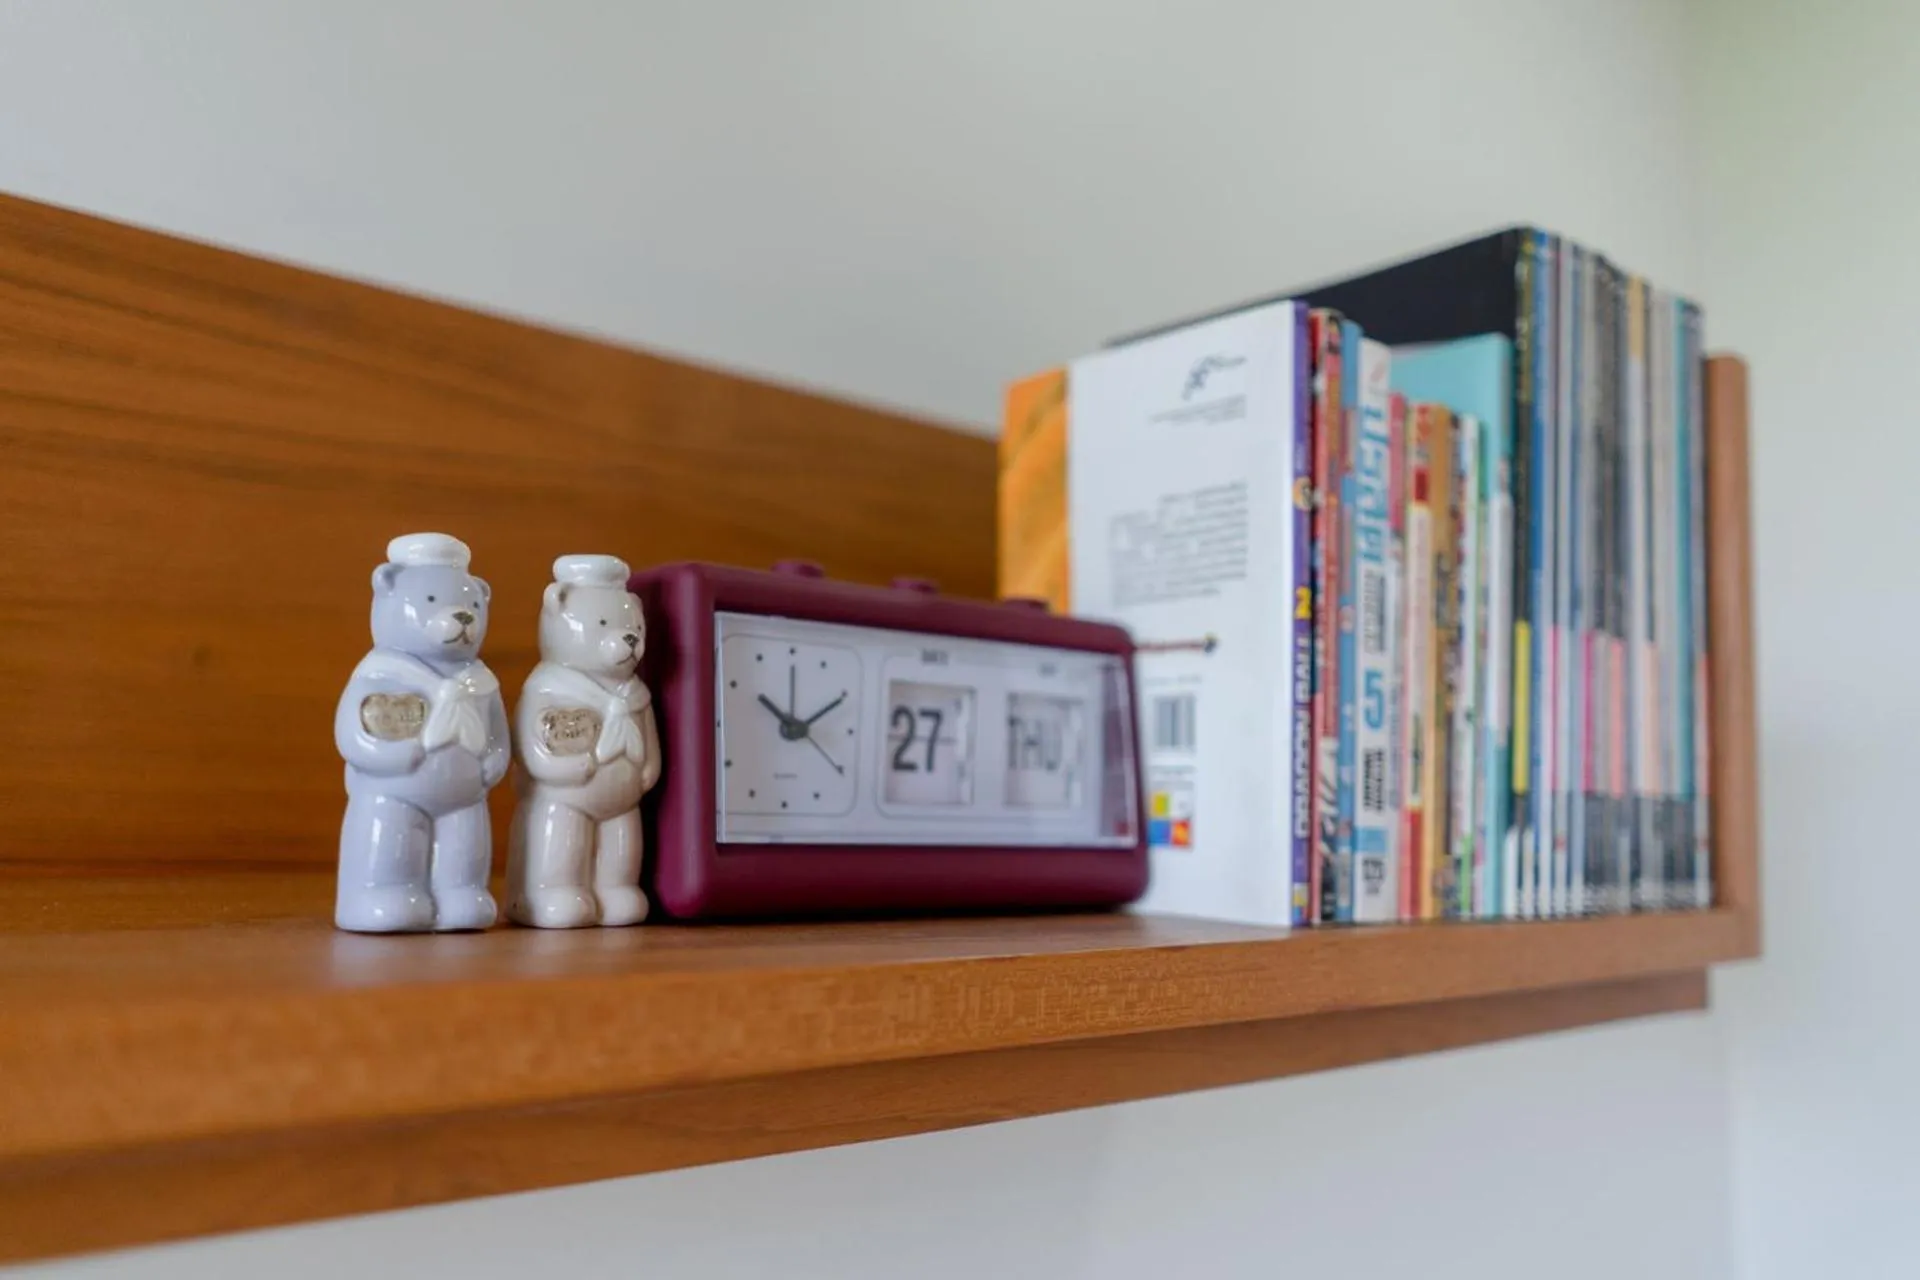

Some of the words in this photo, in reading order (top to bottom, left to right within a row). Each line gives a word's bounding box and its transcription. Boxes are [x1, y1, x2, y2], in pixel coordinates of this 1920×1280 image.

[1295, 586, 1312, 619] 2
[1295, 637, 1311, 703] BALL
[1363, 668, 1385, 731] 5
[891, 704, 943, 772] 27
